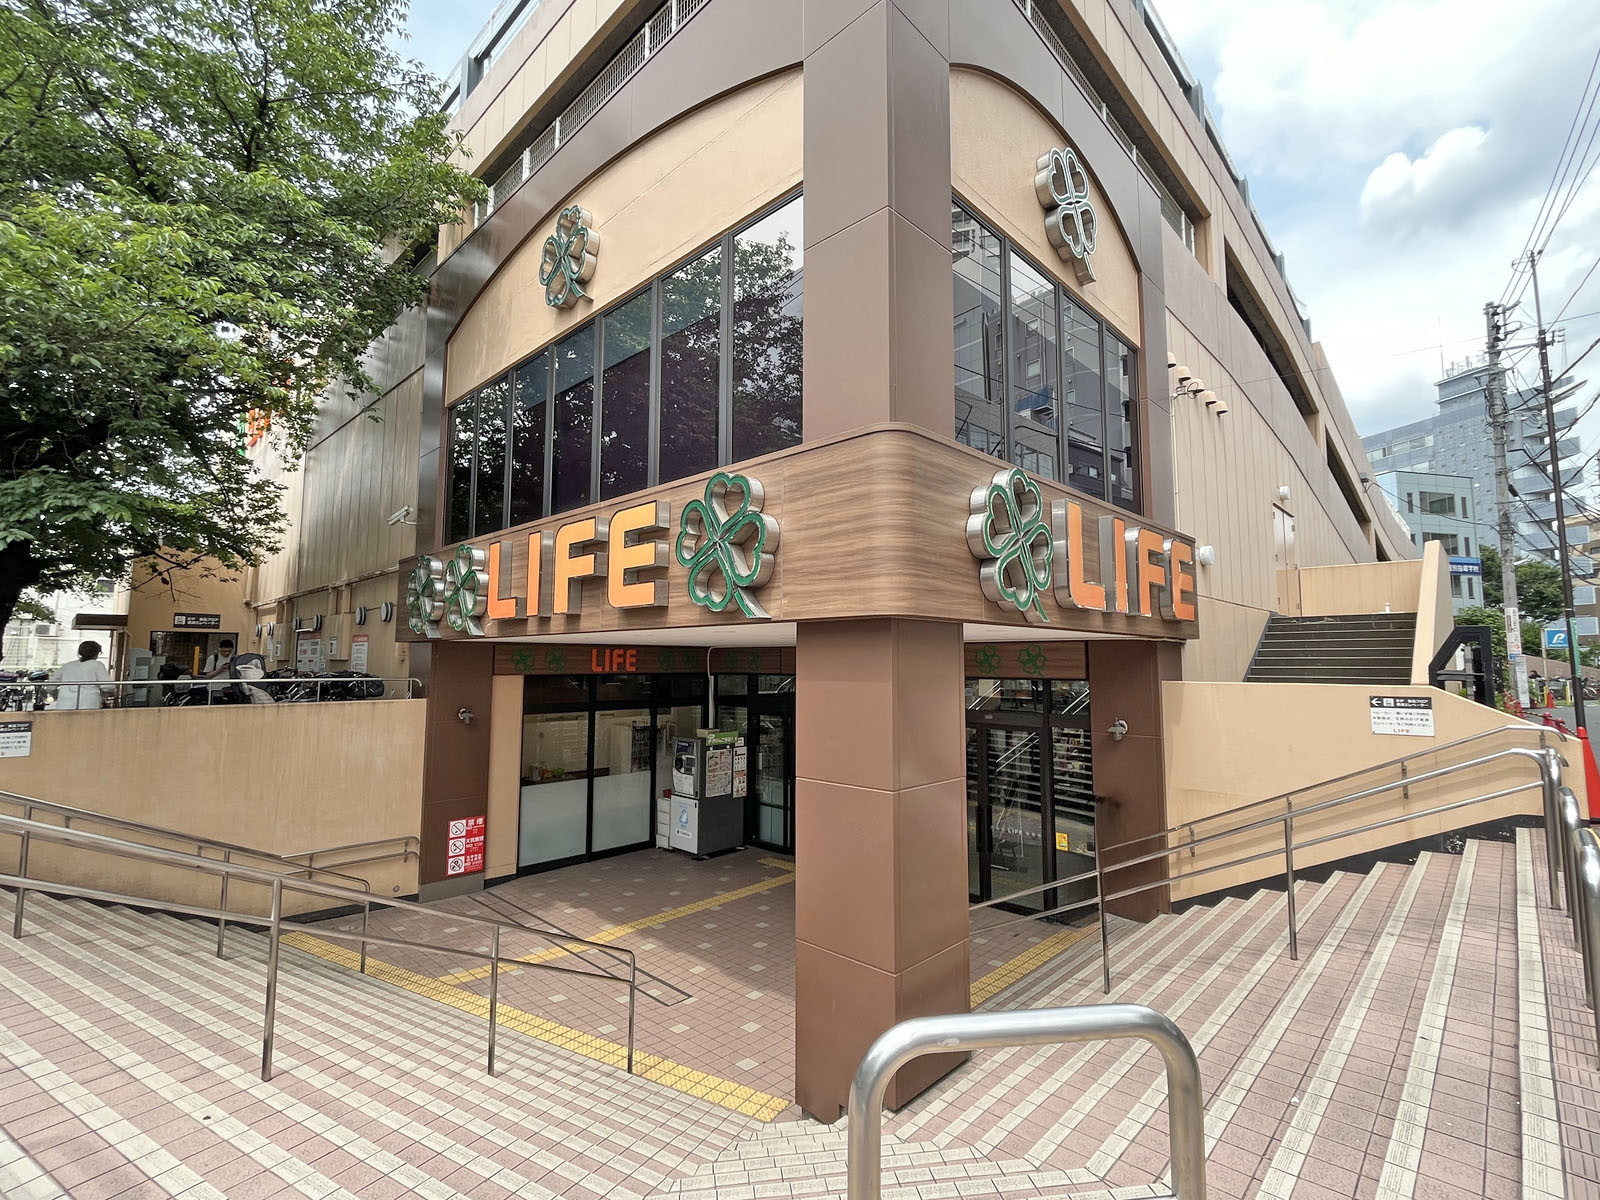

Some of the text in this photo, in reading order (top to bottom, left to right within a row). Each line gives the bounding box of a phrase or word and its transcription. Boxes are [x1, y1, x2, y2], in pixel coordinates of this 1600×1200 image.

[487, 500, 670, 620] LIFE
[1052, 499, 1195, 621] LIFE
[590, 648, 638, 673] LIFE
